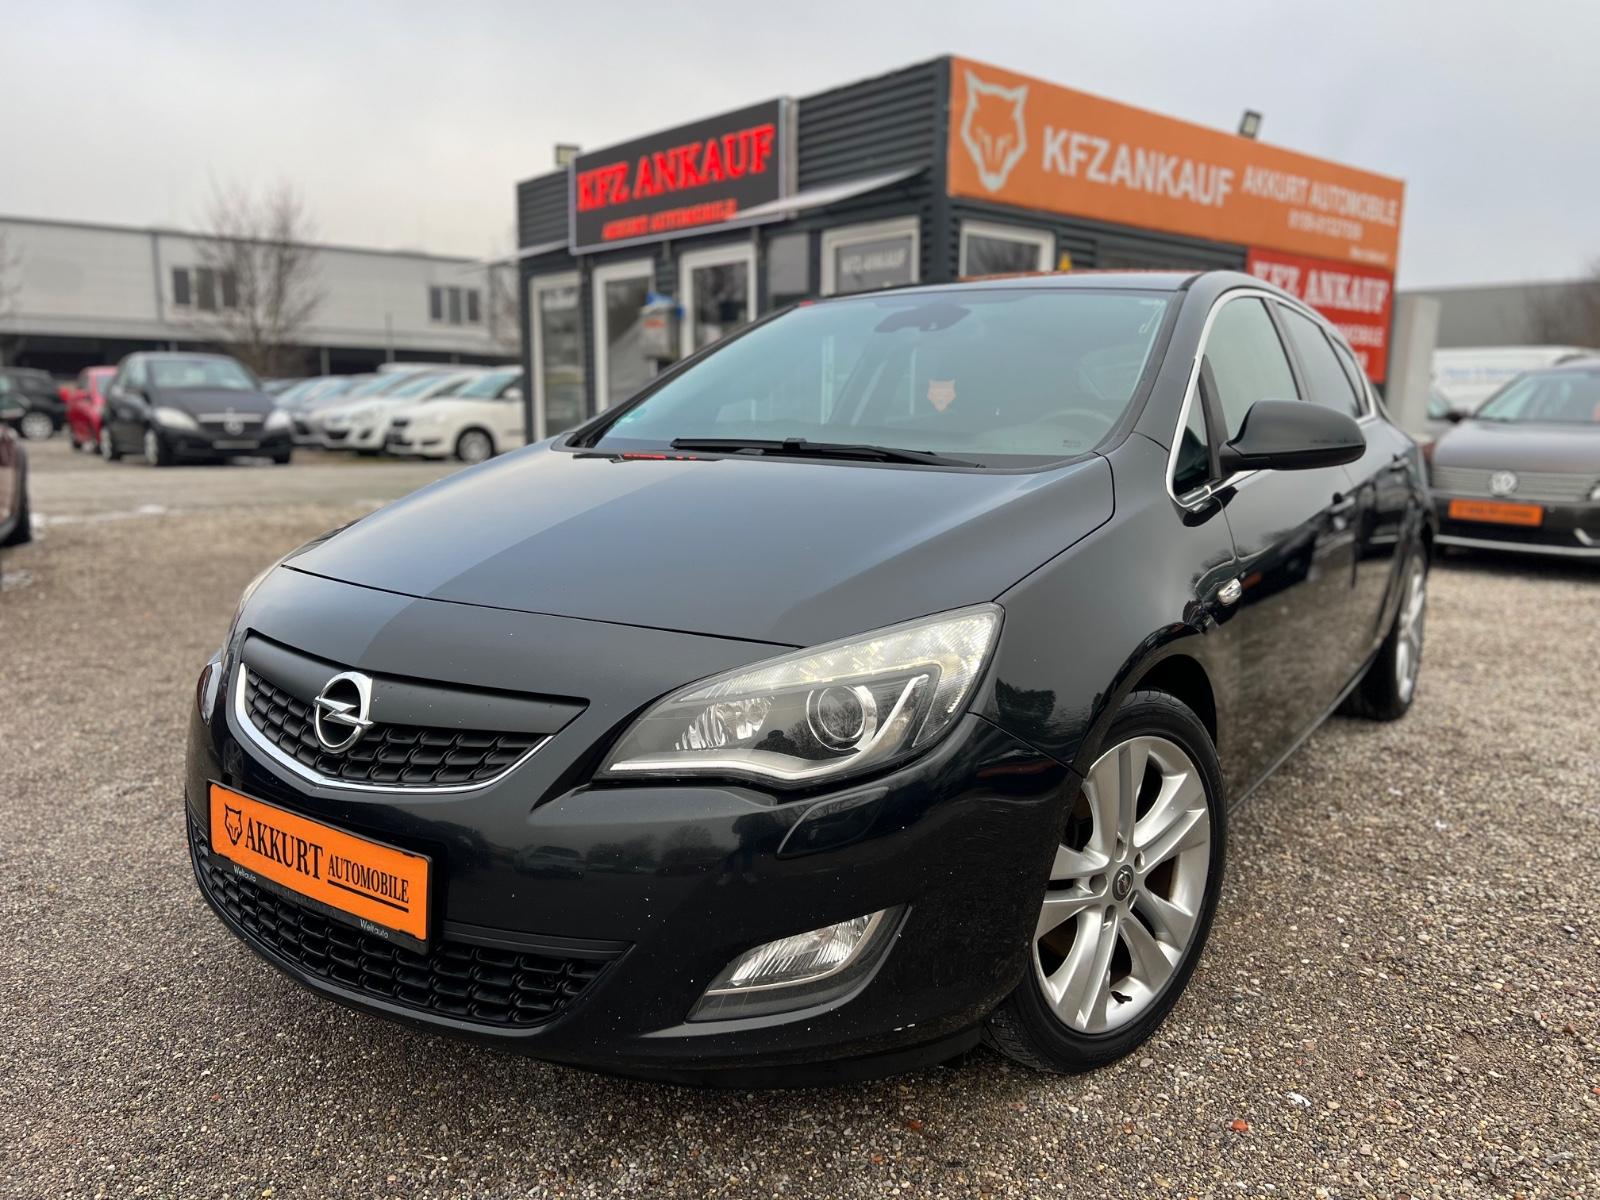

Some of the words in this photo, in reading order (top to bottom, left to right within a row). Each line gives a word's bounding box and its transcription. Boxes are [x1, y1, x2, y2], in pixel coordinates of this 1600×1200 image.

[577, 162, 629, 212] KFZ
[633, 123, 776, 199] ANKAUF
[1304, 268, 1390, 314] ANKAUF
[245, 816, 324, 880] AKKURT
[327, 853, 410, 904] AUTOMOBILE
